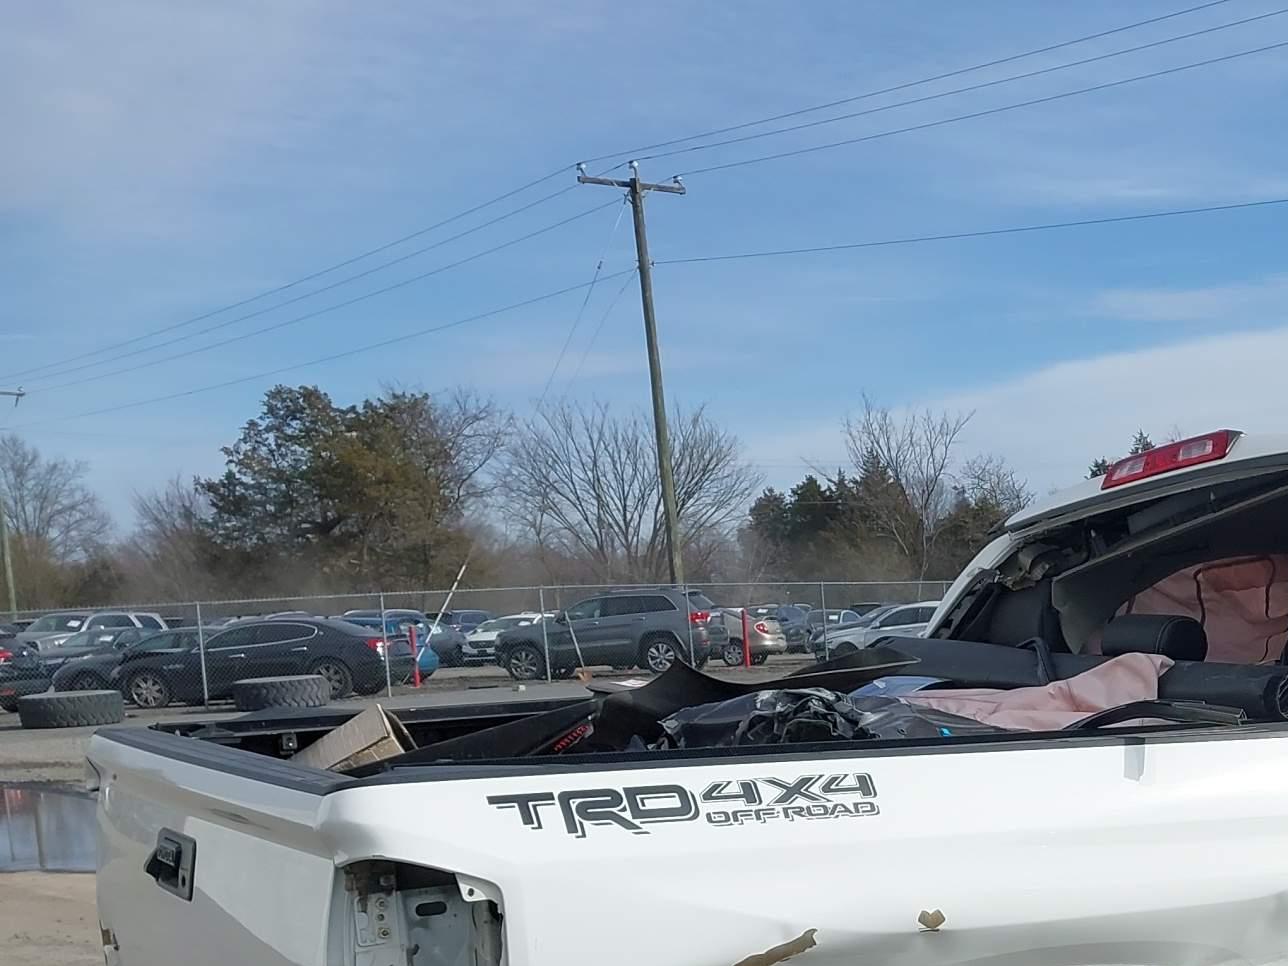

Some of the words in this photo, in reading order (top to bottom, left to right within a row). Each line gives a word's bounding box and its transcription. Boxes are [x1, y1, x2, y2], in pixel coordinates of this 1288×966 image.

[486, 784, 700, 838] TRD
[699, 773, 878, 807] 4X4
[705, 807, 780, 826] OFF
[782, 802, 881, 822] ROAD
